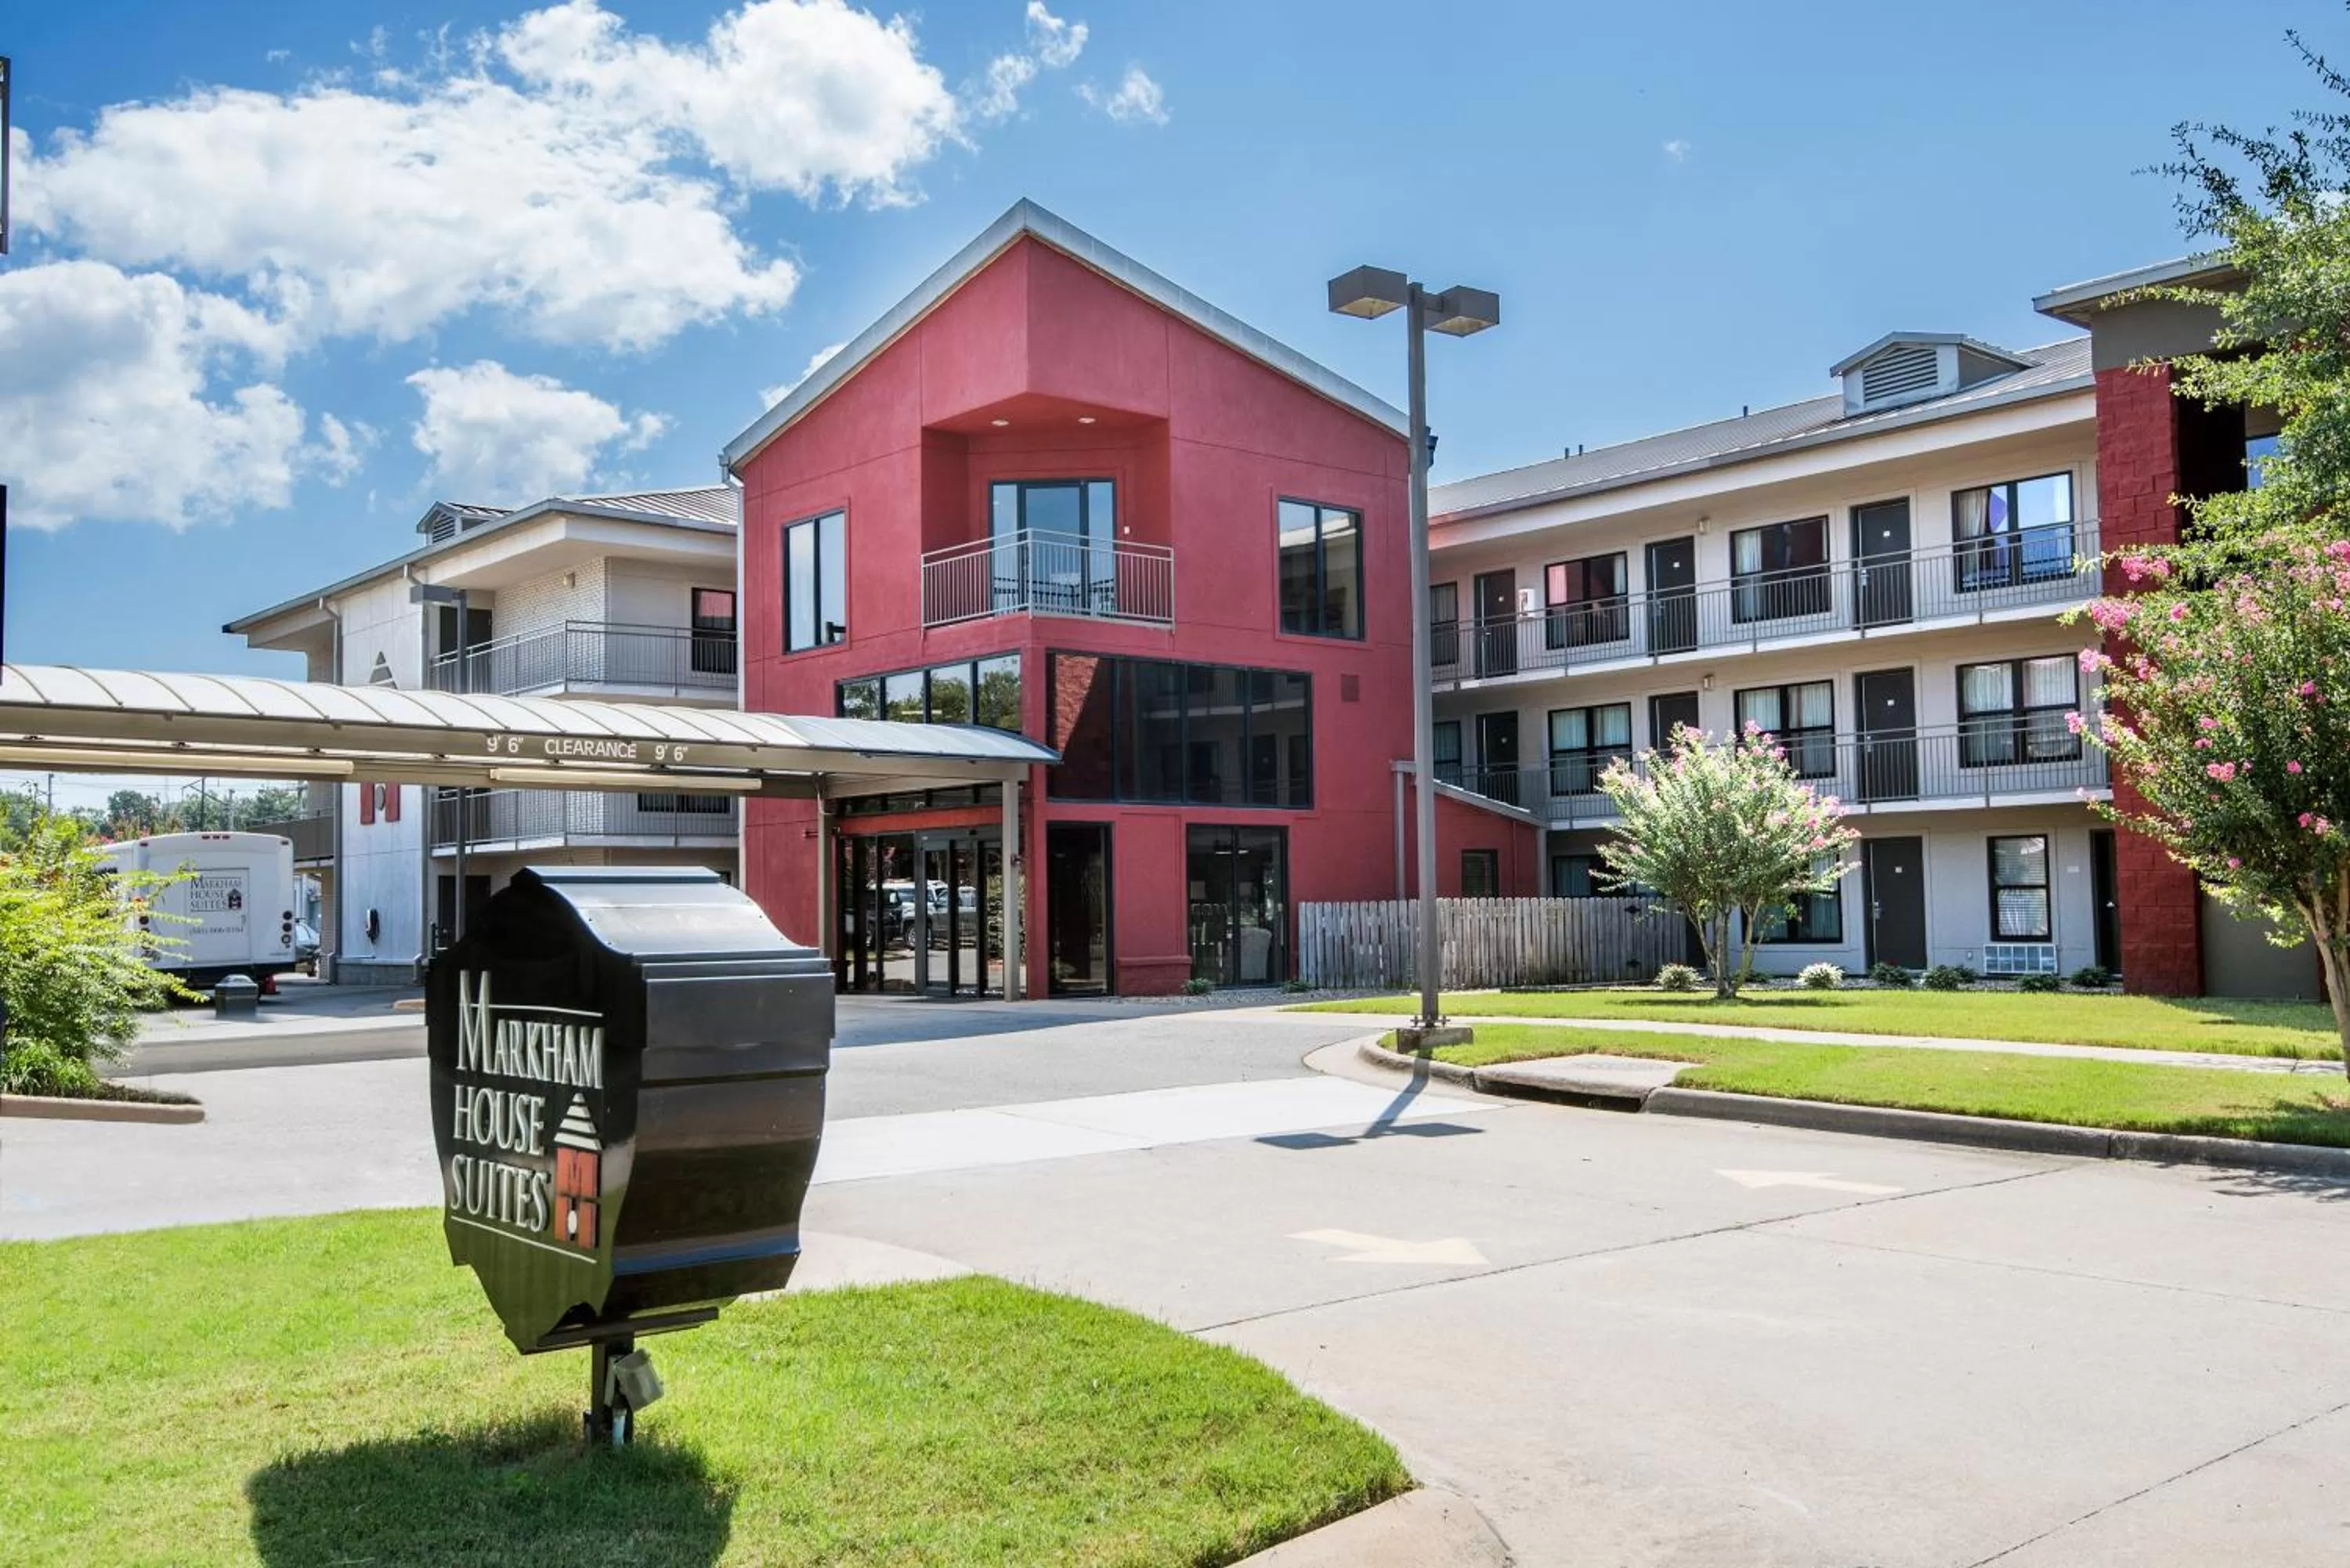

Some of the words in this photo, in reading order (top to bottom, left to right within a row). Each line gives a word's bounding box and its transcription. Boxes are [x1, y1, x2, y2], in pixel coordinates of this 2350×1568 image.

[544, 739, 637, 758] CLEARANCE
[456, 970, 604, 1089] MARKHAM
[454, 1084, 546, 1156] HOUSE
[450, 1154, 550, 1233] SUITES
